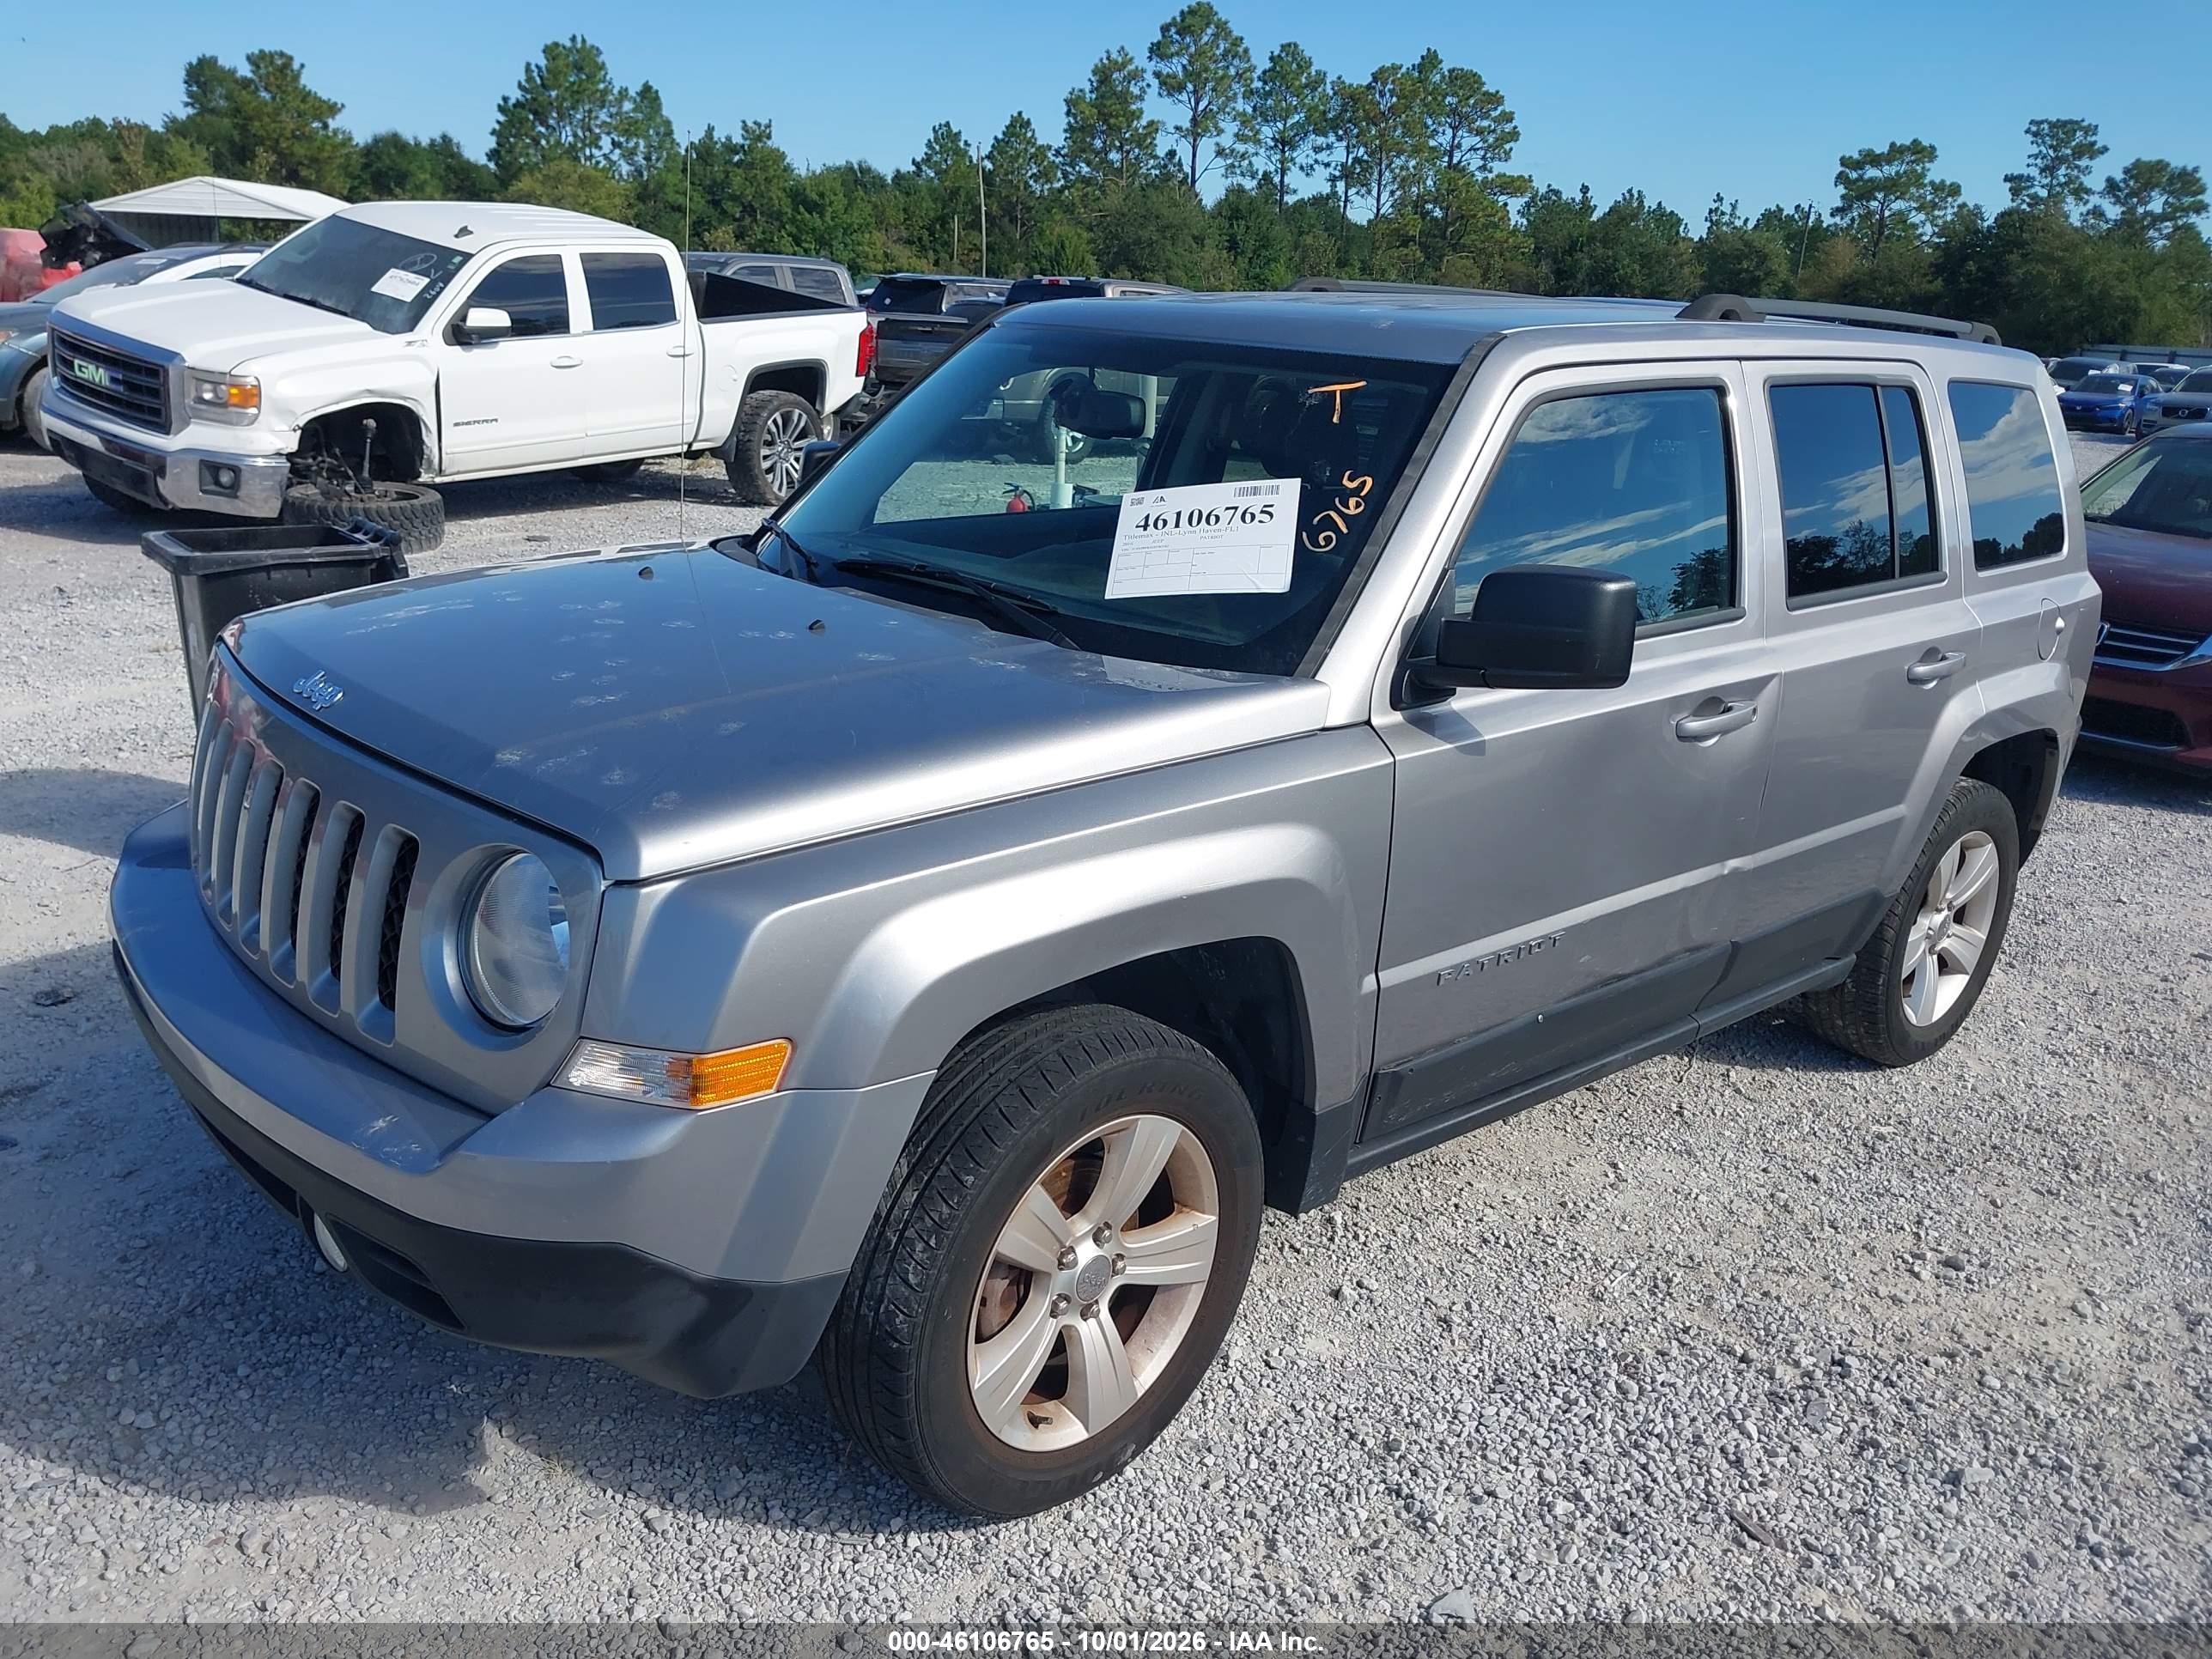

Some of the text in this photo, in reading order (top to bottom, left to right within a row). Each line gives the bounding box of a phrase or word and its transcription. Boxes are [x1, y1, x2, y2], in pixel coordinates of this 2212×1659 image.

[1308, 380, 1367, 423] T
[453, 418, 498, 427] SIERRA
[1134, 503, 1276, 532] 46106765
[1302, 471, 1373, 552] 6765
[294, 670, 343, 710] Jeep
[1437, 932, 1566, 986] PATRIOT
